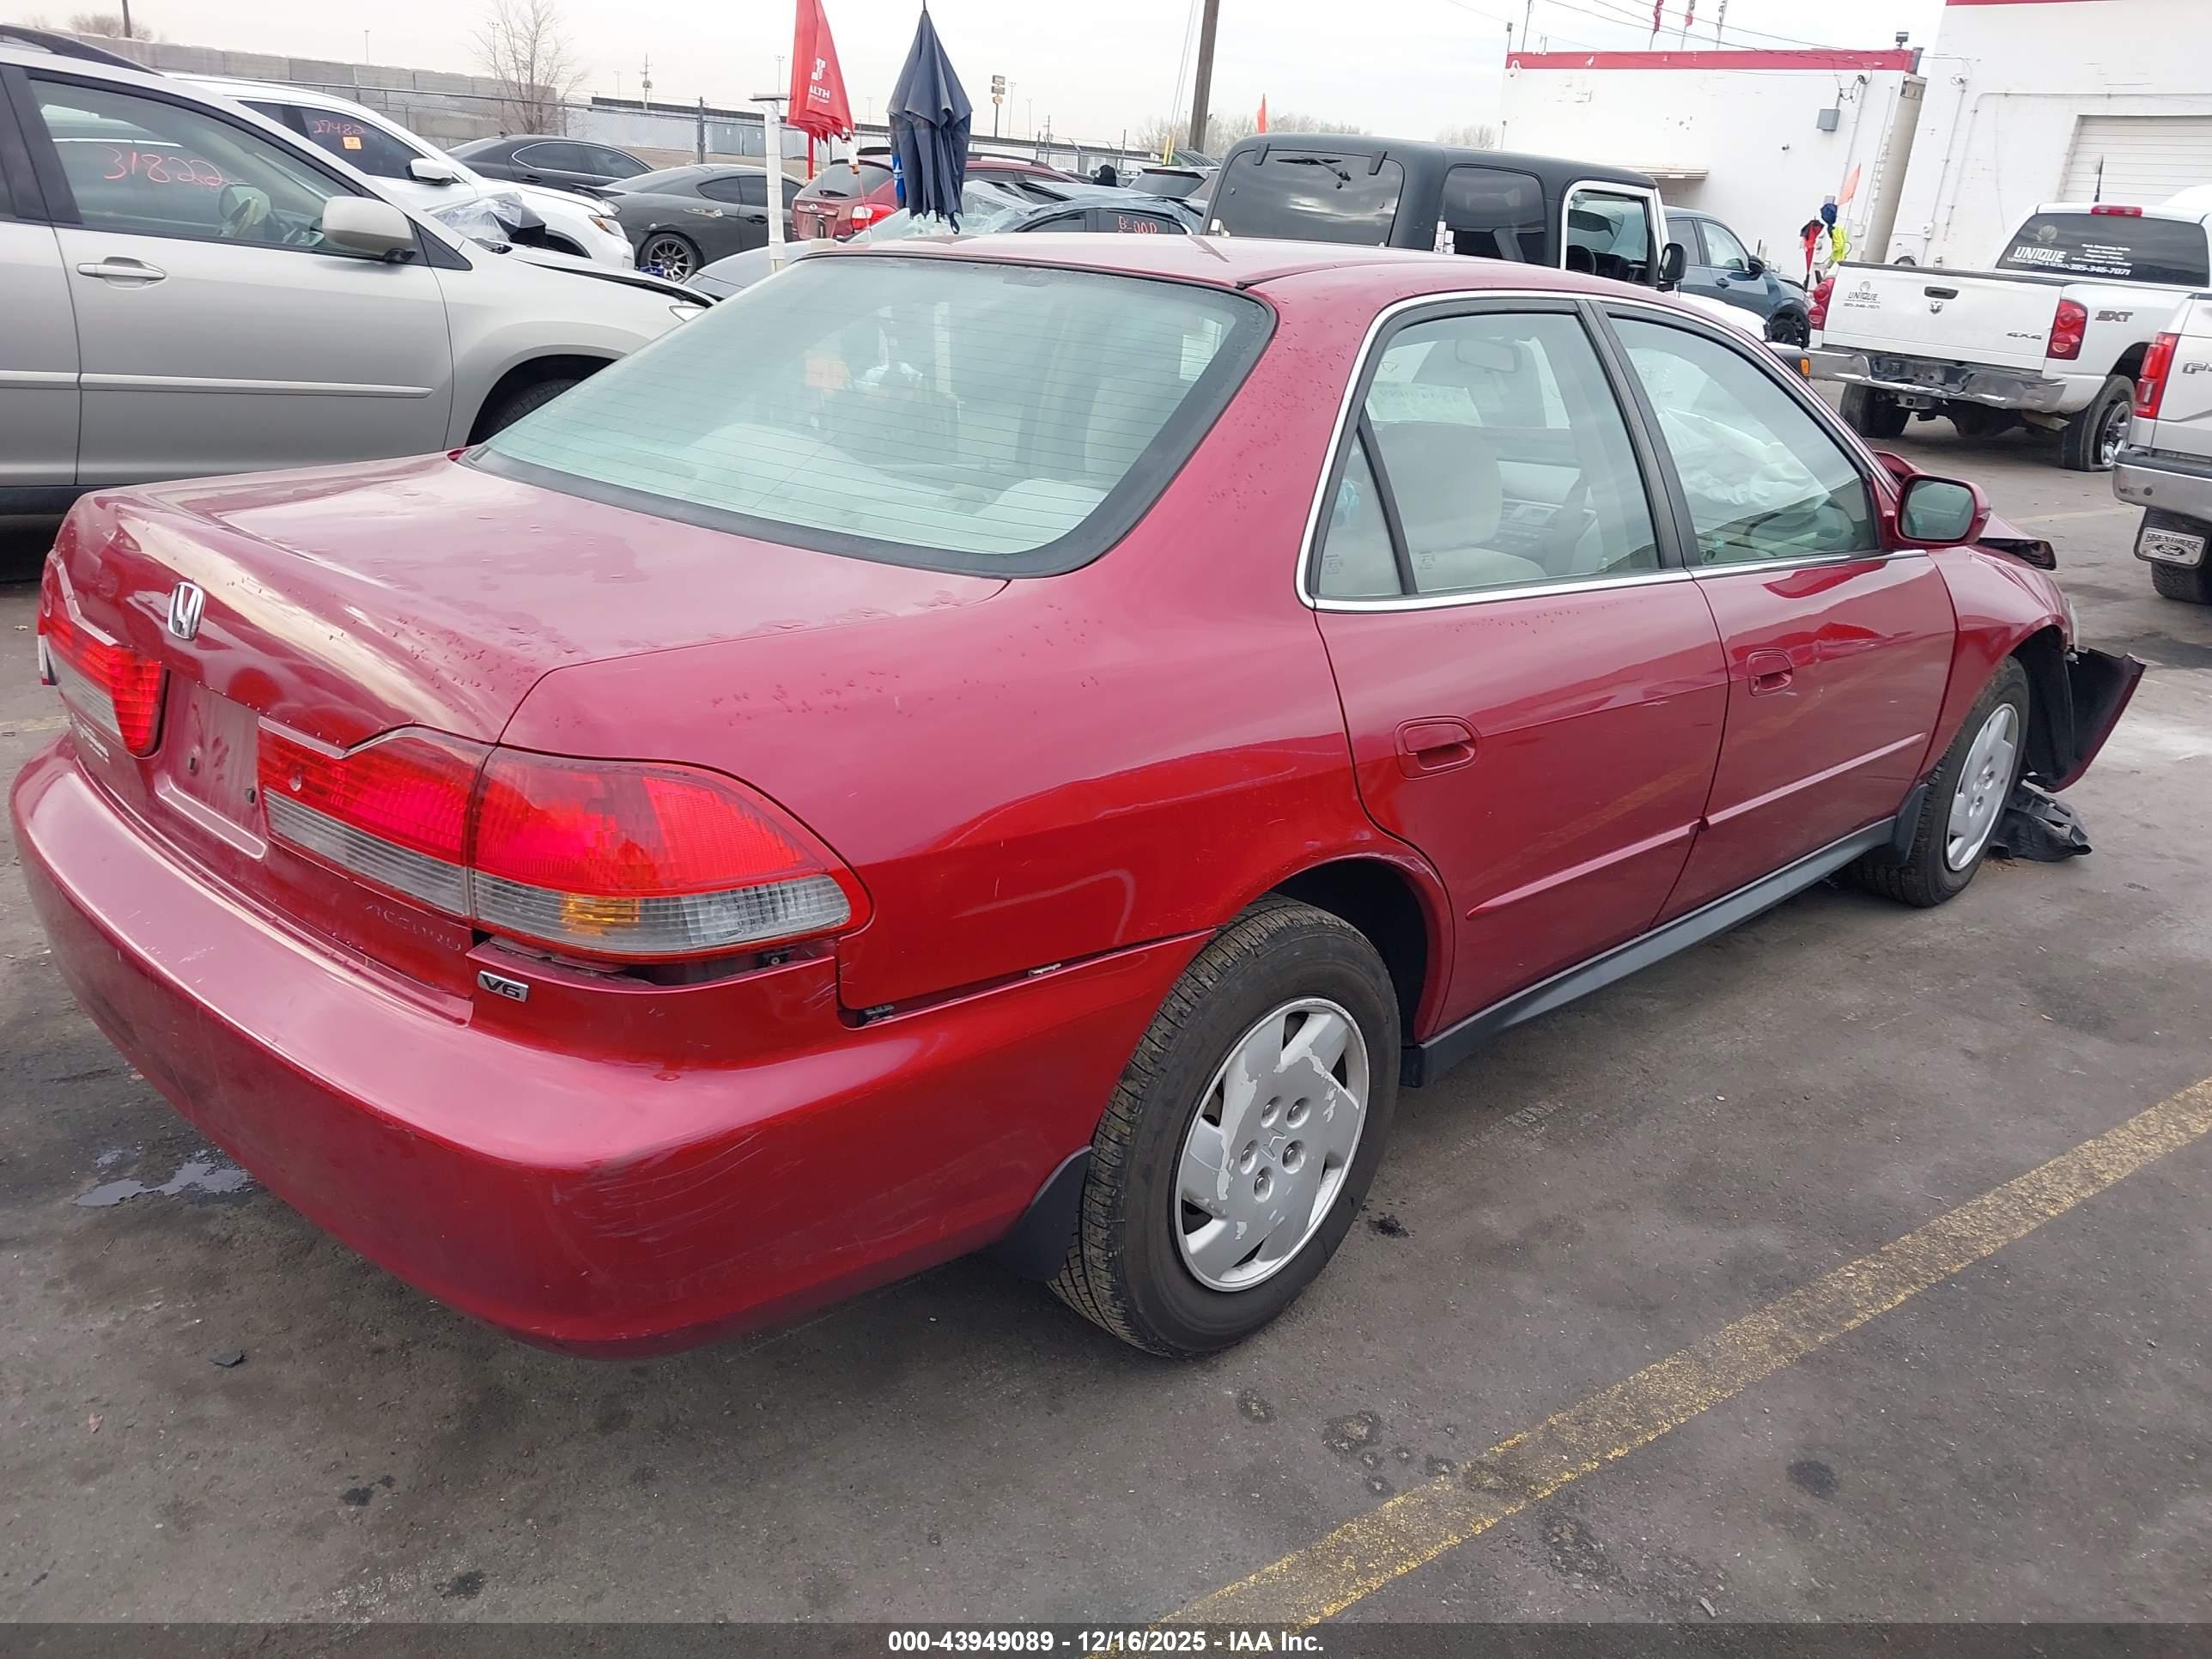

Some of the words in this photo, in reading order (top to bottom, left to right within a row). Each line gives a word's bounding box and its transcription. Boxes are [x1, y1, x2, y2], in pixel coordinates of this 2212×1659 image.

[96, 143, 225, 186] 31822
[2013, 246, 2068, 263] UNIQUE
[1848, 291, 1879, 301] UNIQUE
[481, 974, 521, 1000] V6
